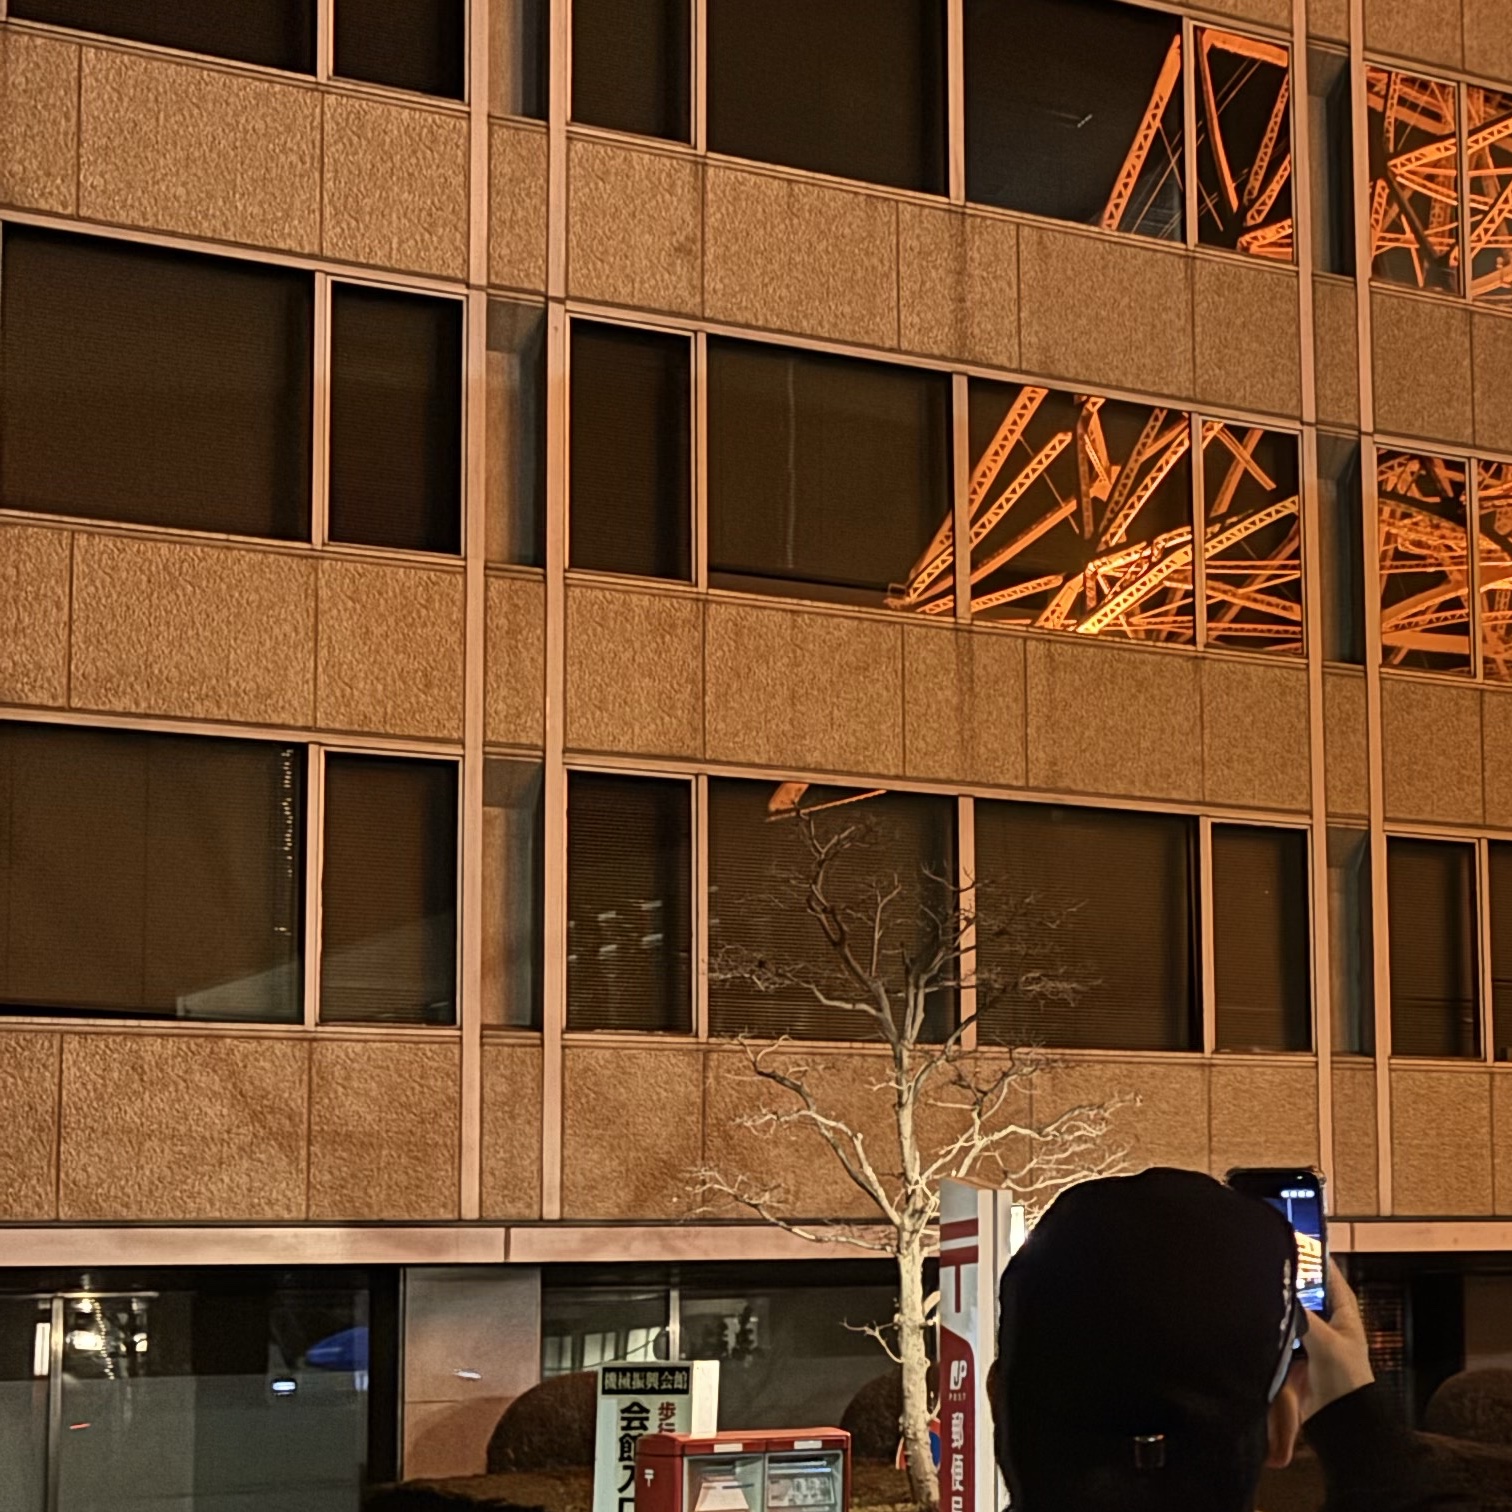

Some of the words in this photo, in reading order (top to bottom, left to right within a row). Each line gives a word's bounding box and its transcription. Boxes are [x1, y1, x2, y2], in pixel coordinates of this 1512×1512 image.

[604, 1370, 688, 1391] 機械振興会館
